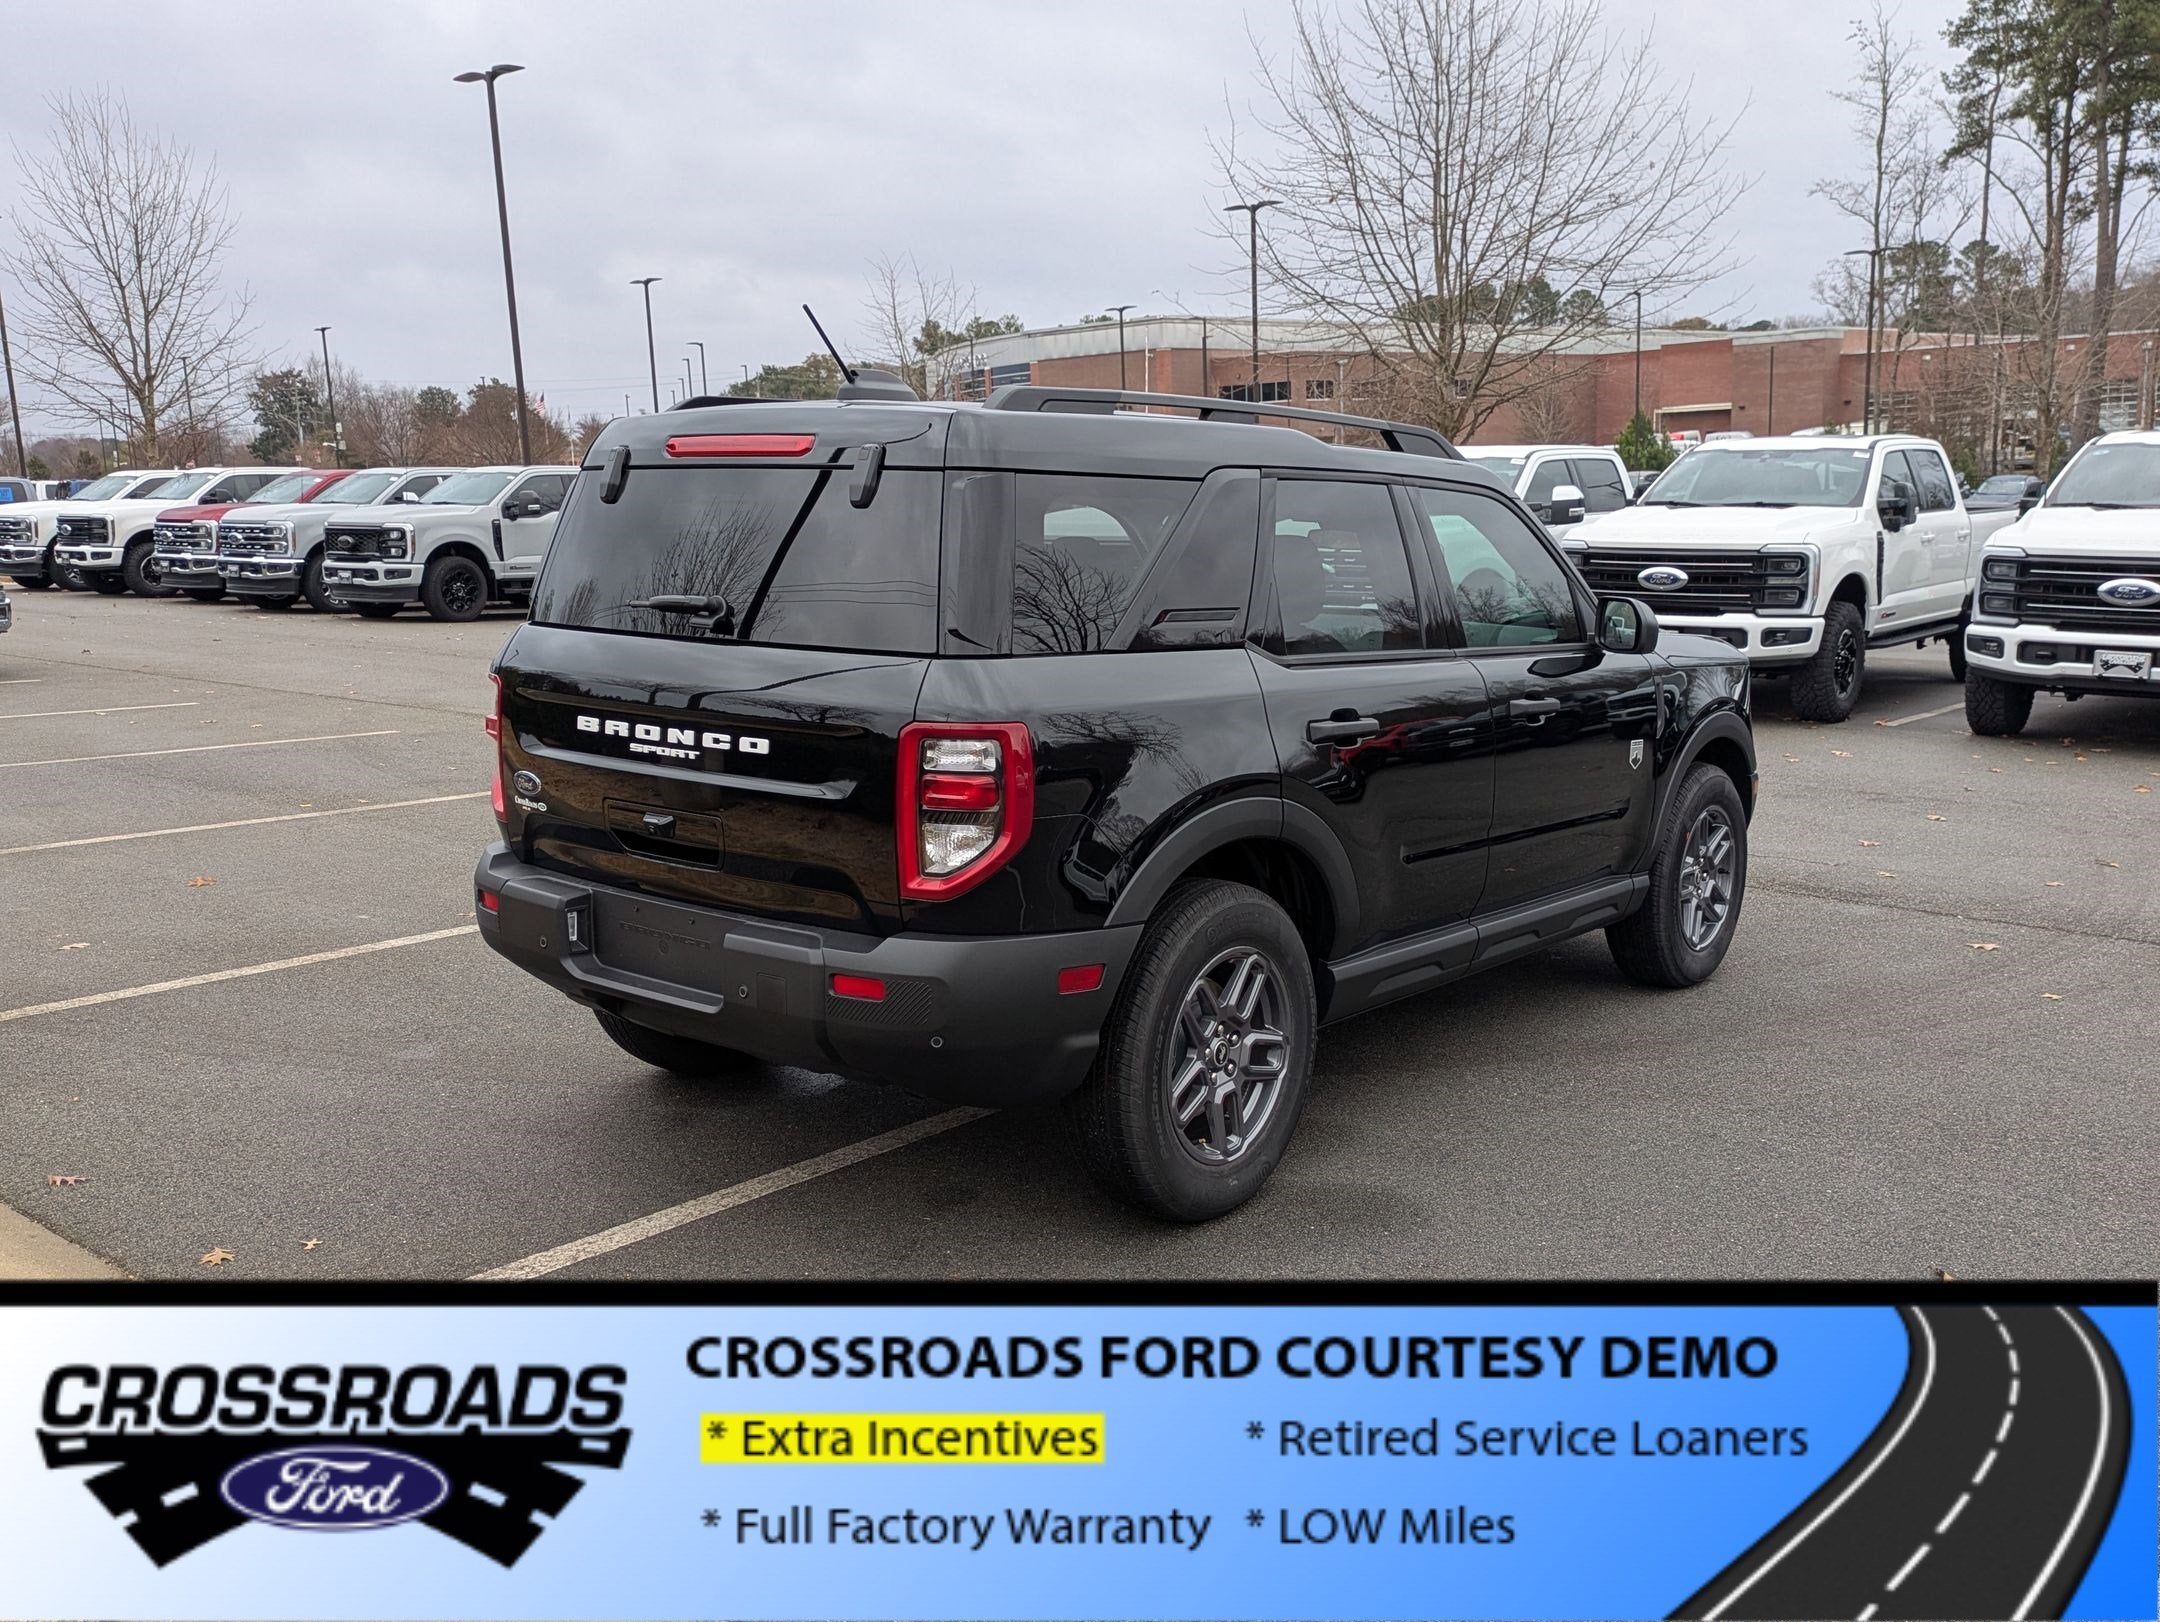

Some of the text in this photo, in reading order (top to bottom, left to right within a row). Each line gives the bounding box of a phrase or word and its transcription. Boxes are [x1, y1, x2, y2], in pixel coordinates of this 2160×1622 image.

[2114, 586, 2146, 599] Ford
[577, 715, 770, 754] BRONCO
[629, 743, 700, 760] SPORT
